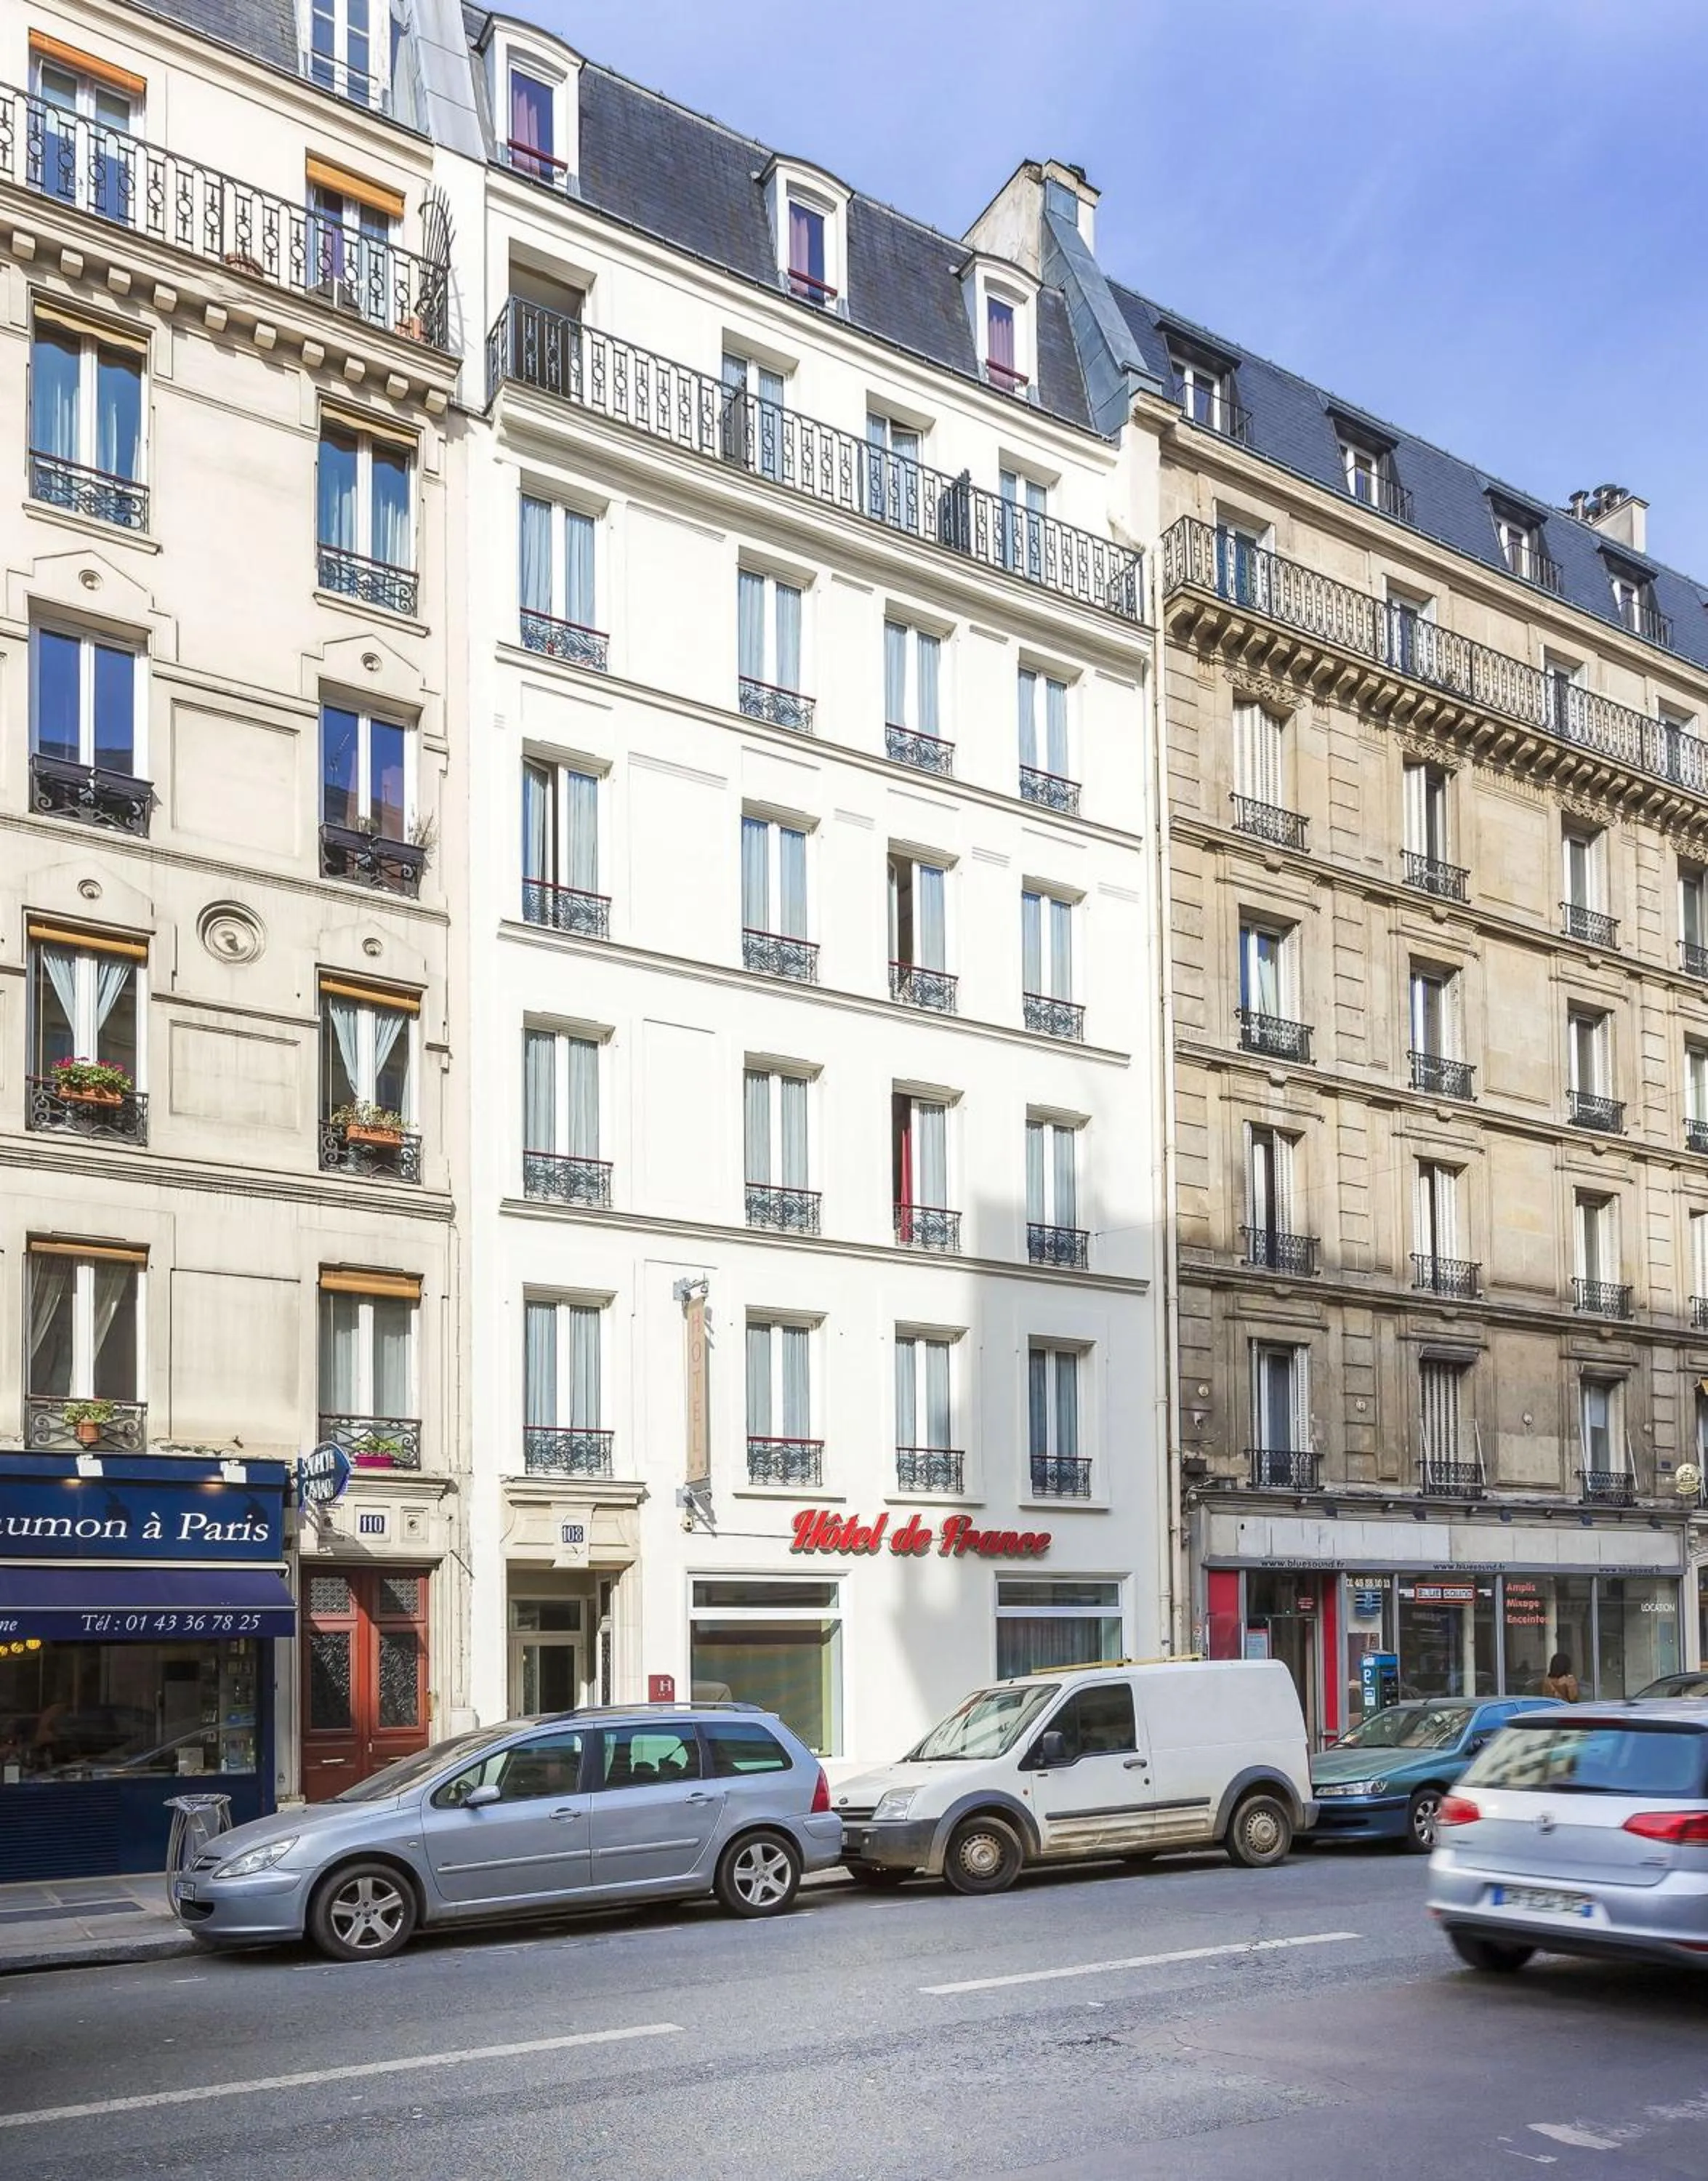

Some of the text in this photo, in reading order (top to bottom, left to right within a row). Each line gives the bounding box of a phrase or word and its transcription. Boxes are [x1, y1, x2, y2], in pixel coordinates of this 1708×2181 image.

[691, 1310, 701, 1453] HOTEL
[0, 1511, 269, 1542] umon à Paris
[361, 1516, 383, 1533] 110
[563, 1526, 583, 1542] 108
[789, 1509, 1052, 1559] Hôtel de France
[1505, 1581, 1536, 1594] Amplis
[1506, 1598, 1540, 1610] Mixage
[1640, 1603, 1675, 1612] LOCATION
[81, 1614, 111, 1631] Tél
[126, 1614, 148, 1632] 01
[153, 1614, 177, 1631] 43
[182, 1614, 207, 1631] 36
[212, 1614, 234, 1631] 78
[238, 1614, 262, 1631] 25
[659, 1679, 672, 1692] H
